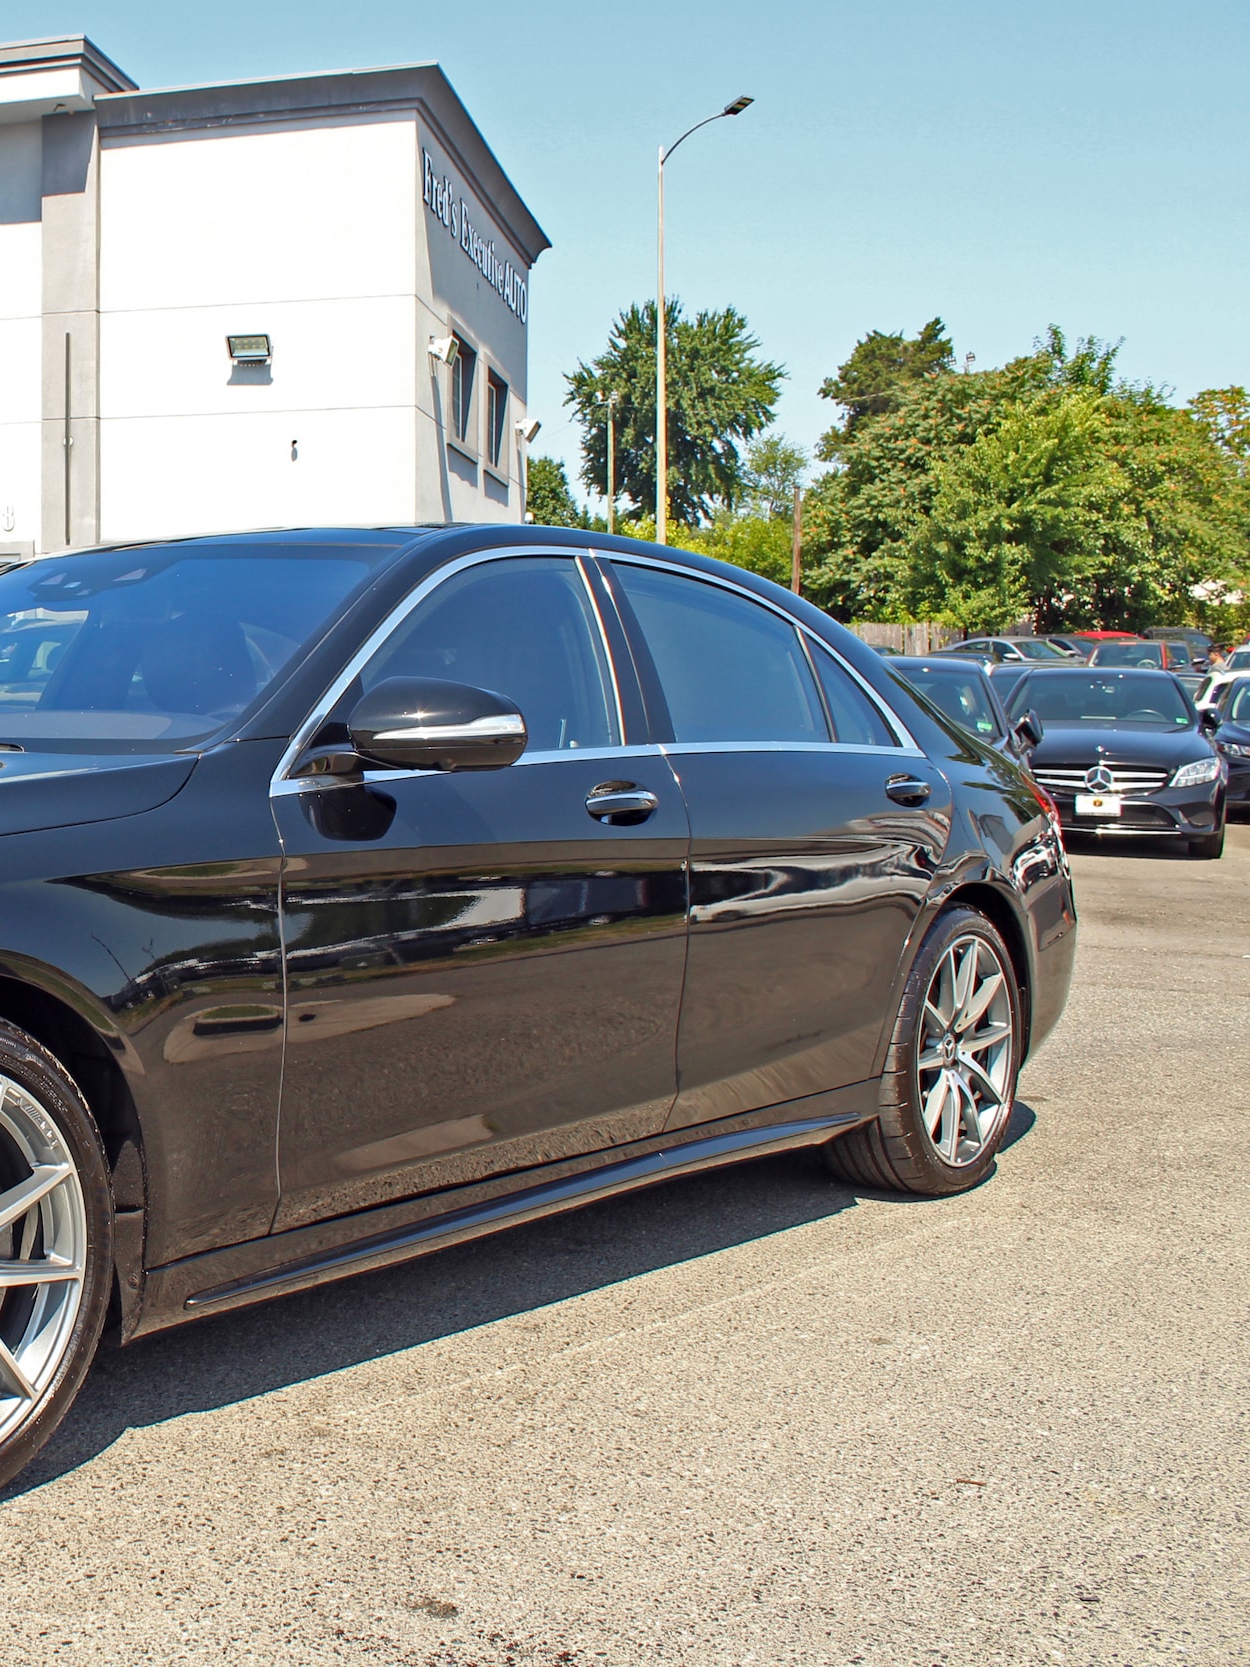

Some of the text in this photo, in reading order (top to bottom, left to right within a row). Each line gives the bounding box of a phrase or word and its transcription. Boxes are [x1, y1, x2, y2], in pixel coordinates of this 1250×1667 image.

[422, 147, 527, 325] Fred's Executive AUTO
